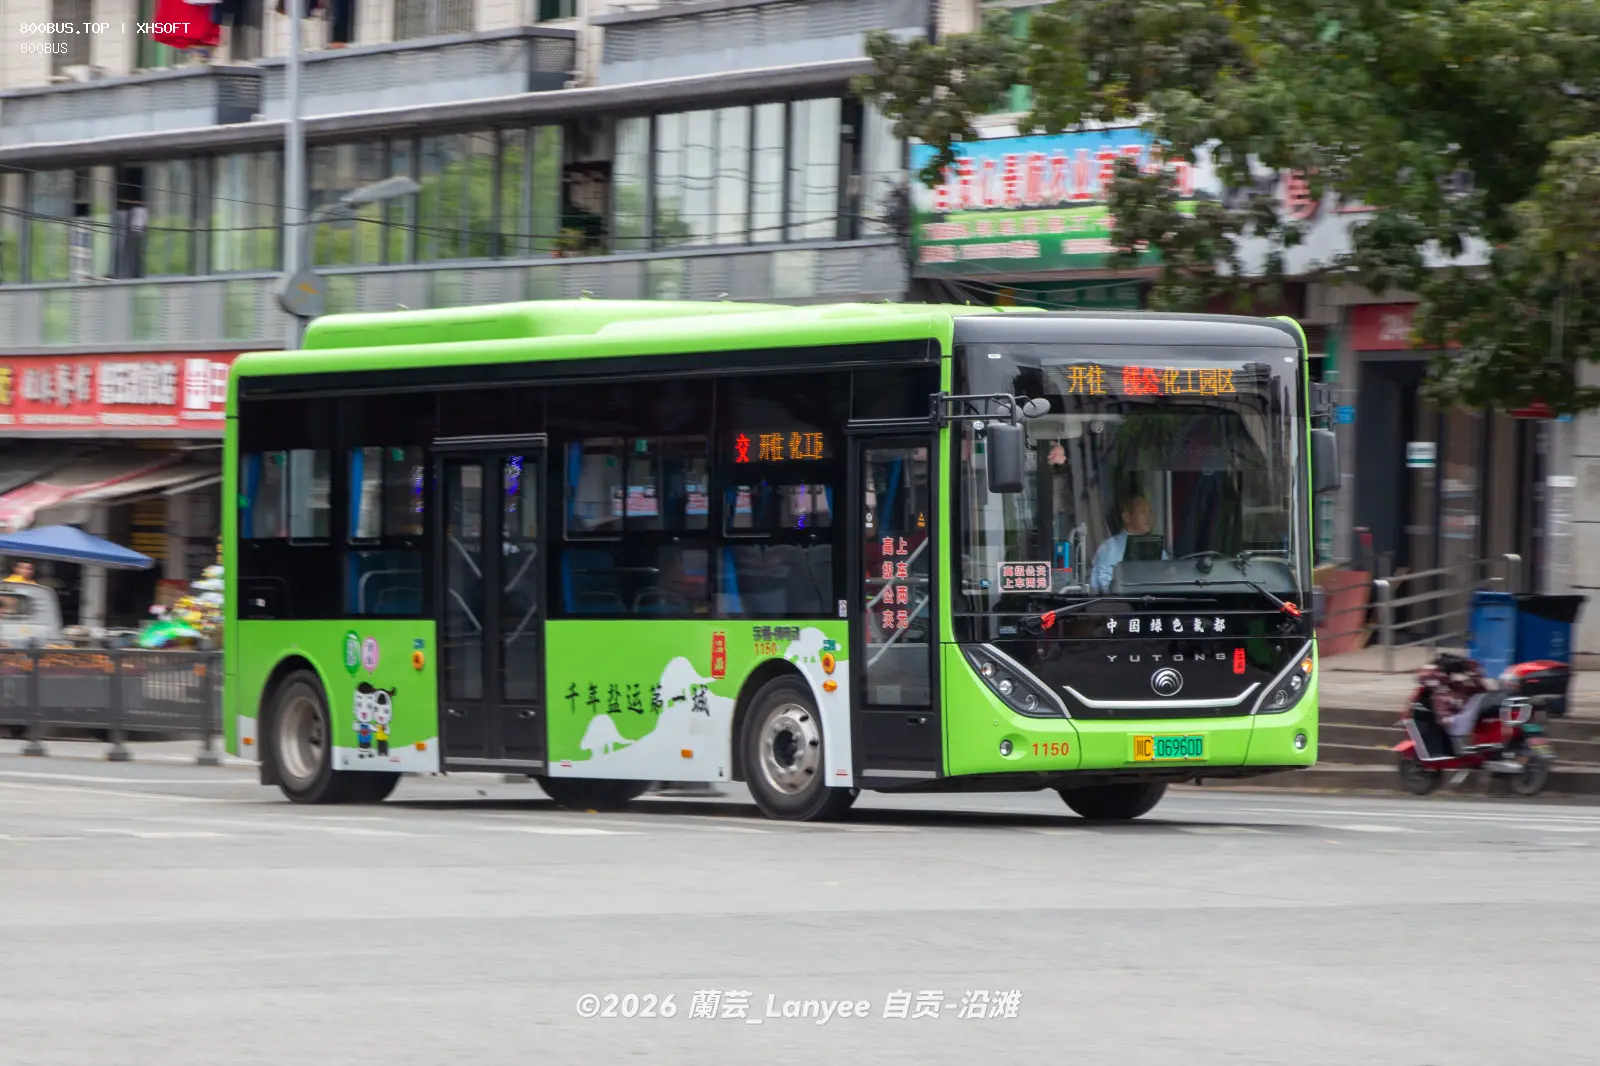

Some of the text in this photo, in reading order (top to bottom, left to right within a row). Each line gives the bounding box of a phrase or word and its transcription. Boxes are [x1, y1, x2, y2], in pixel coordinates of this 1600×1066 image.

[1067, 365, 1107, 396] 开往
[735, 433, 751, 463] 交
[896, 537, 909, 629] 上车两元
[1003, 577, 1047, 588] 上车两元
[1106, 652, 1227, 663] YUTONG
[1032, 742, 1070, 757] 1150
